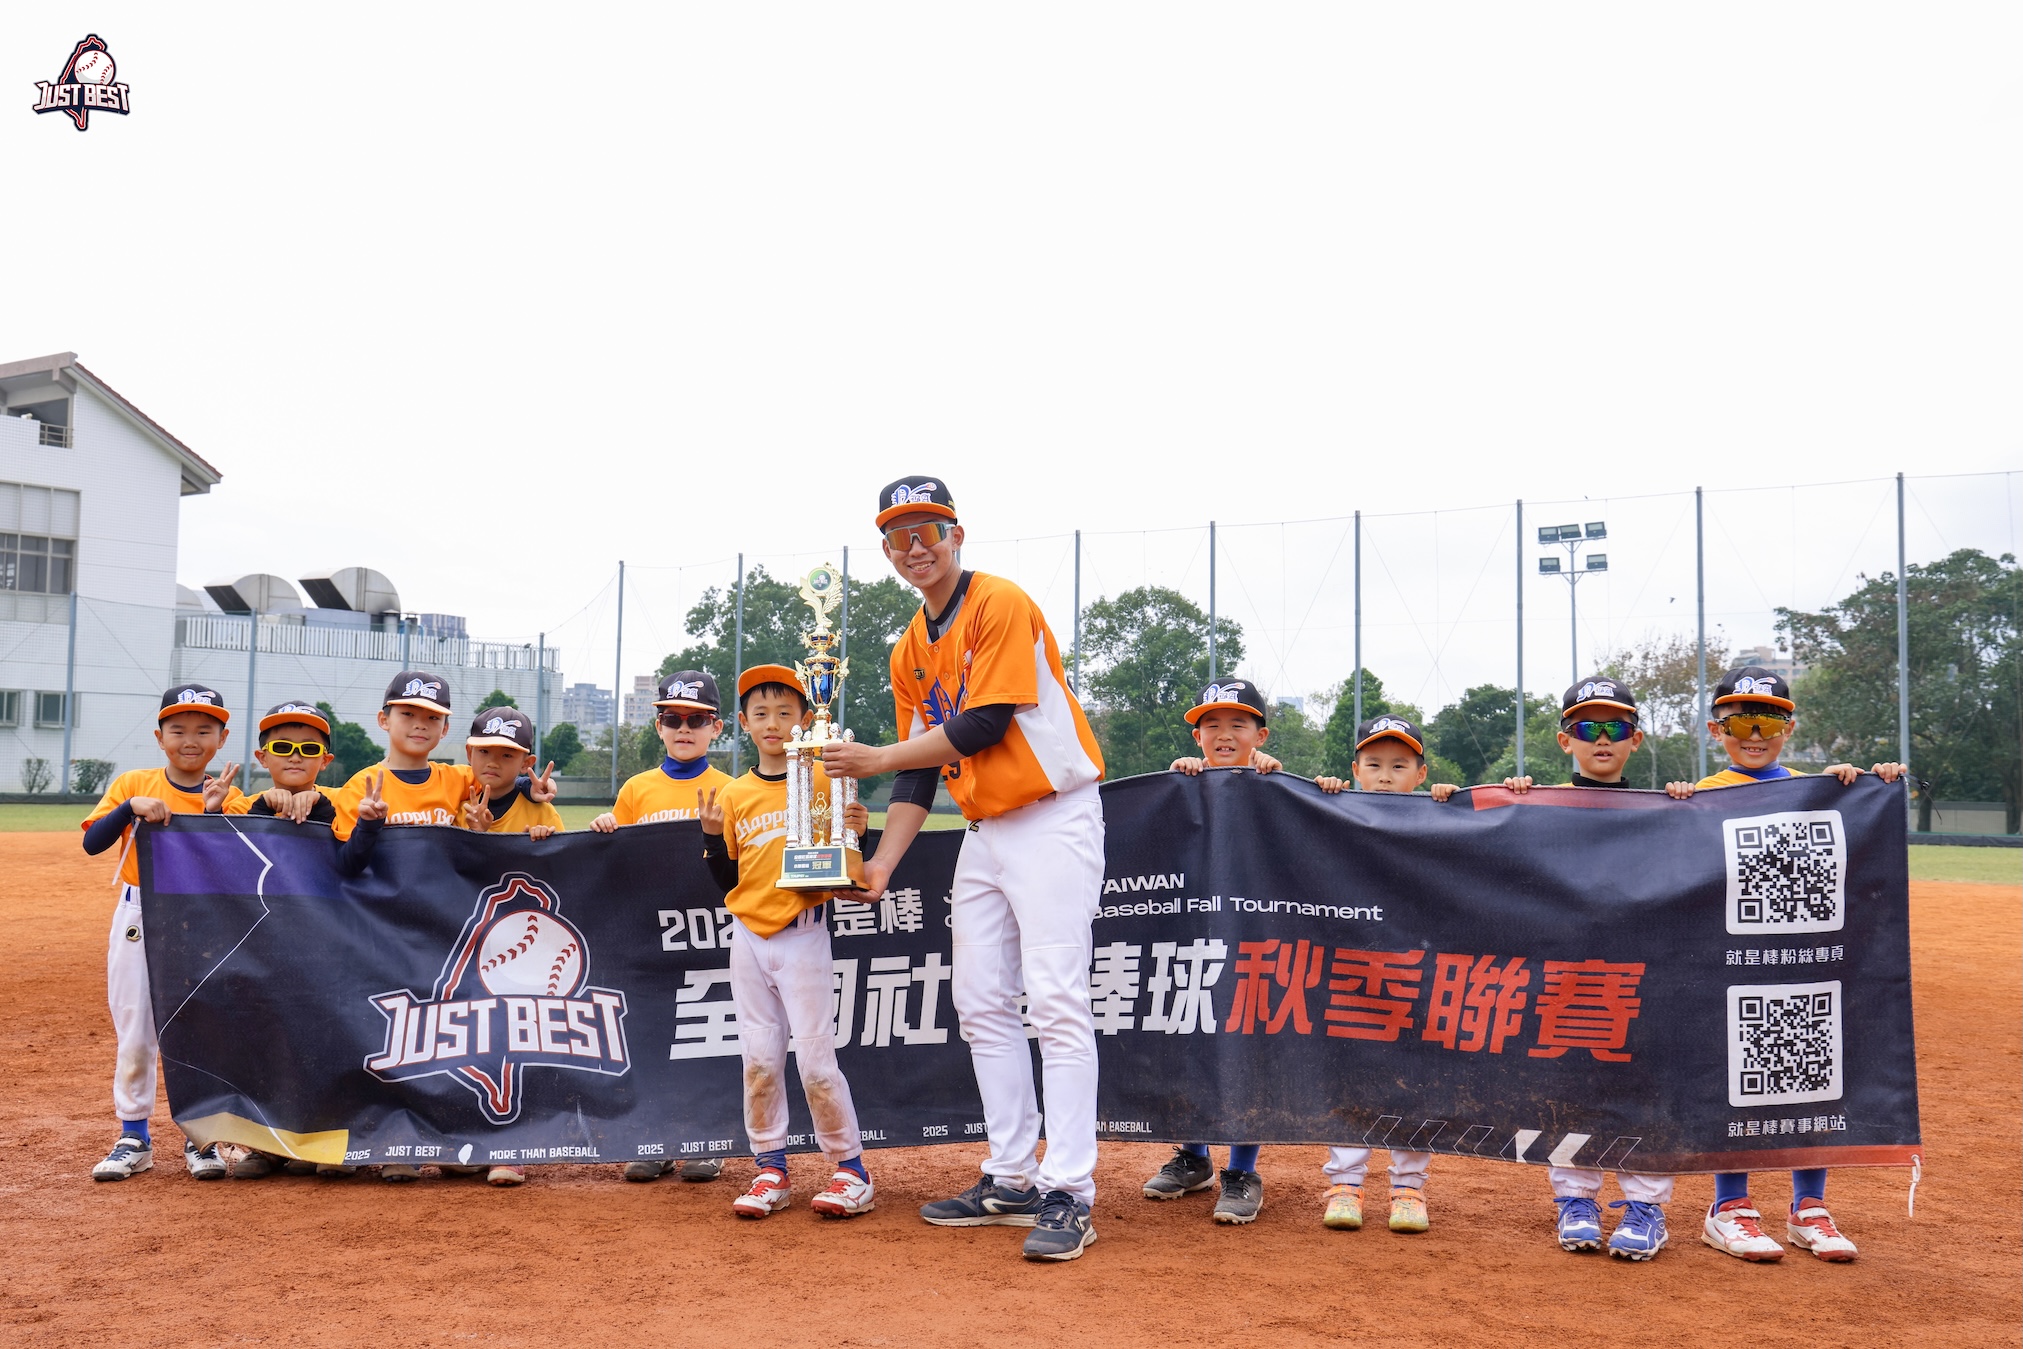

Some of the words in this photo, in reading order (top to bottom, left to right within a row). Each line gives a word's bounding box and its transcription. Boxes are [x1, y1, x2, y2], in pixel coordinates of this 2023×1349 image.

[385, 810, 432, 825] appy
[736, 810, 787, 841] Happ
[1100, 872, 1185, 895] AIWAN
[658, 907, 736, 952] 202
[832, 887, 924, 938] 是棒
[1186, 895, 1222, 913] Fall
[1229, 896, 1384, 921] Tournament
[1725, 944, 1845, 966] 就是棒粉絲專頁
[369, 993, 498, 1071] JUST
[502, 991, 623, 1062] BEST
[922, 1124, 949, 1138] 2025
[1096, 1120, 1107, 1133] AN
[1109, 1120, 1153, 1134] BASEBALL
[344, 1149, 371, 1161] 2025
[385, 1145, 412, 1157] JUST
[414, 1145, 442, 1157] BEST
[489, 1149, 517, 1160] MORE
[520, 1147, 546, 1159] THAN
[549, 1146, 600, 1158] BASEBALL
[637, 1143, 664, 1155] 2025
[680, 1141, 705, 1153] JUST
[708, 1139, 734, 1151] BEST
[786, 1133, 806, 1146] ORE
[859, 1129, 887, 1141] BALL
